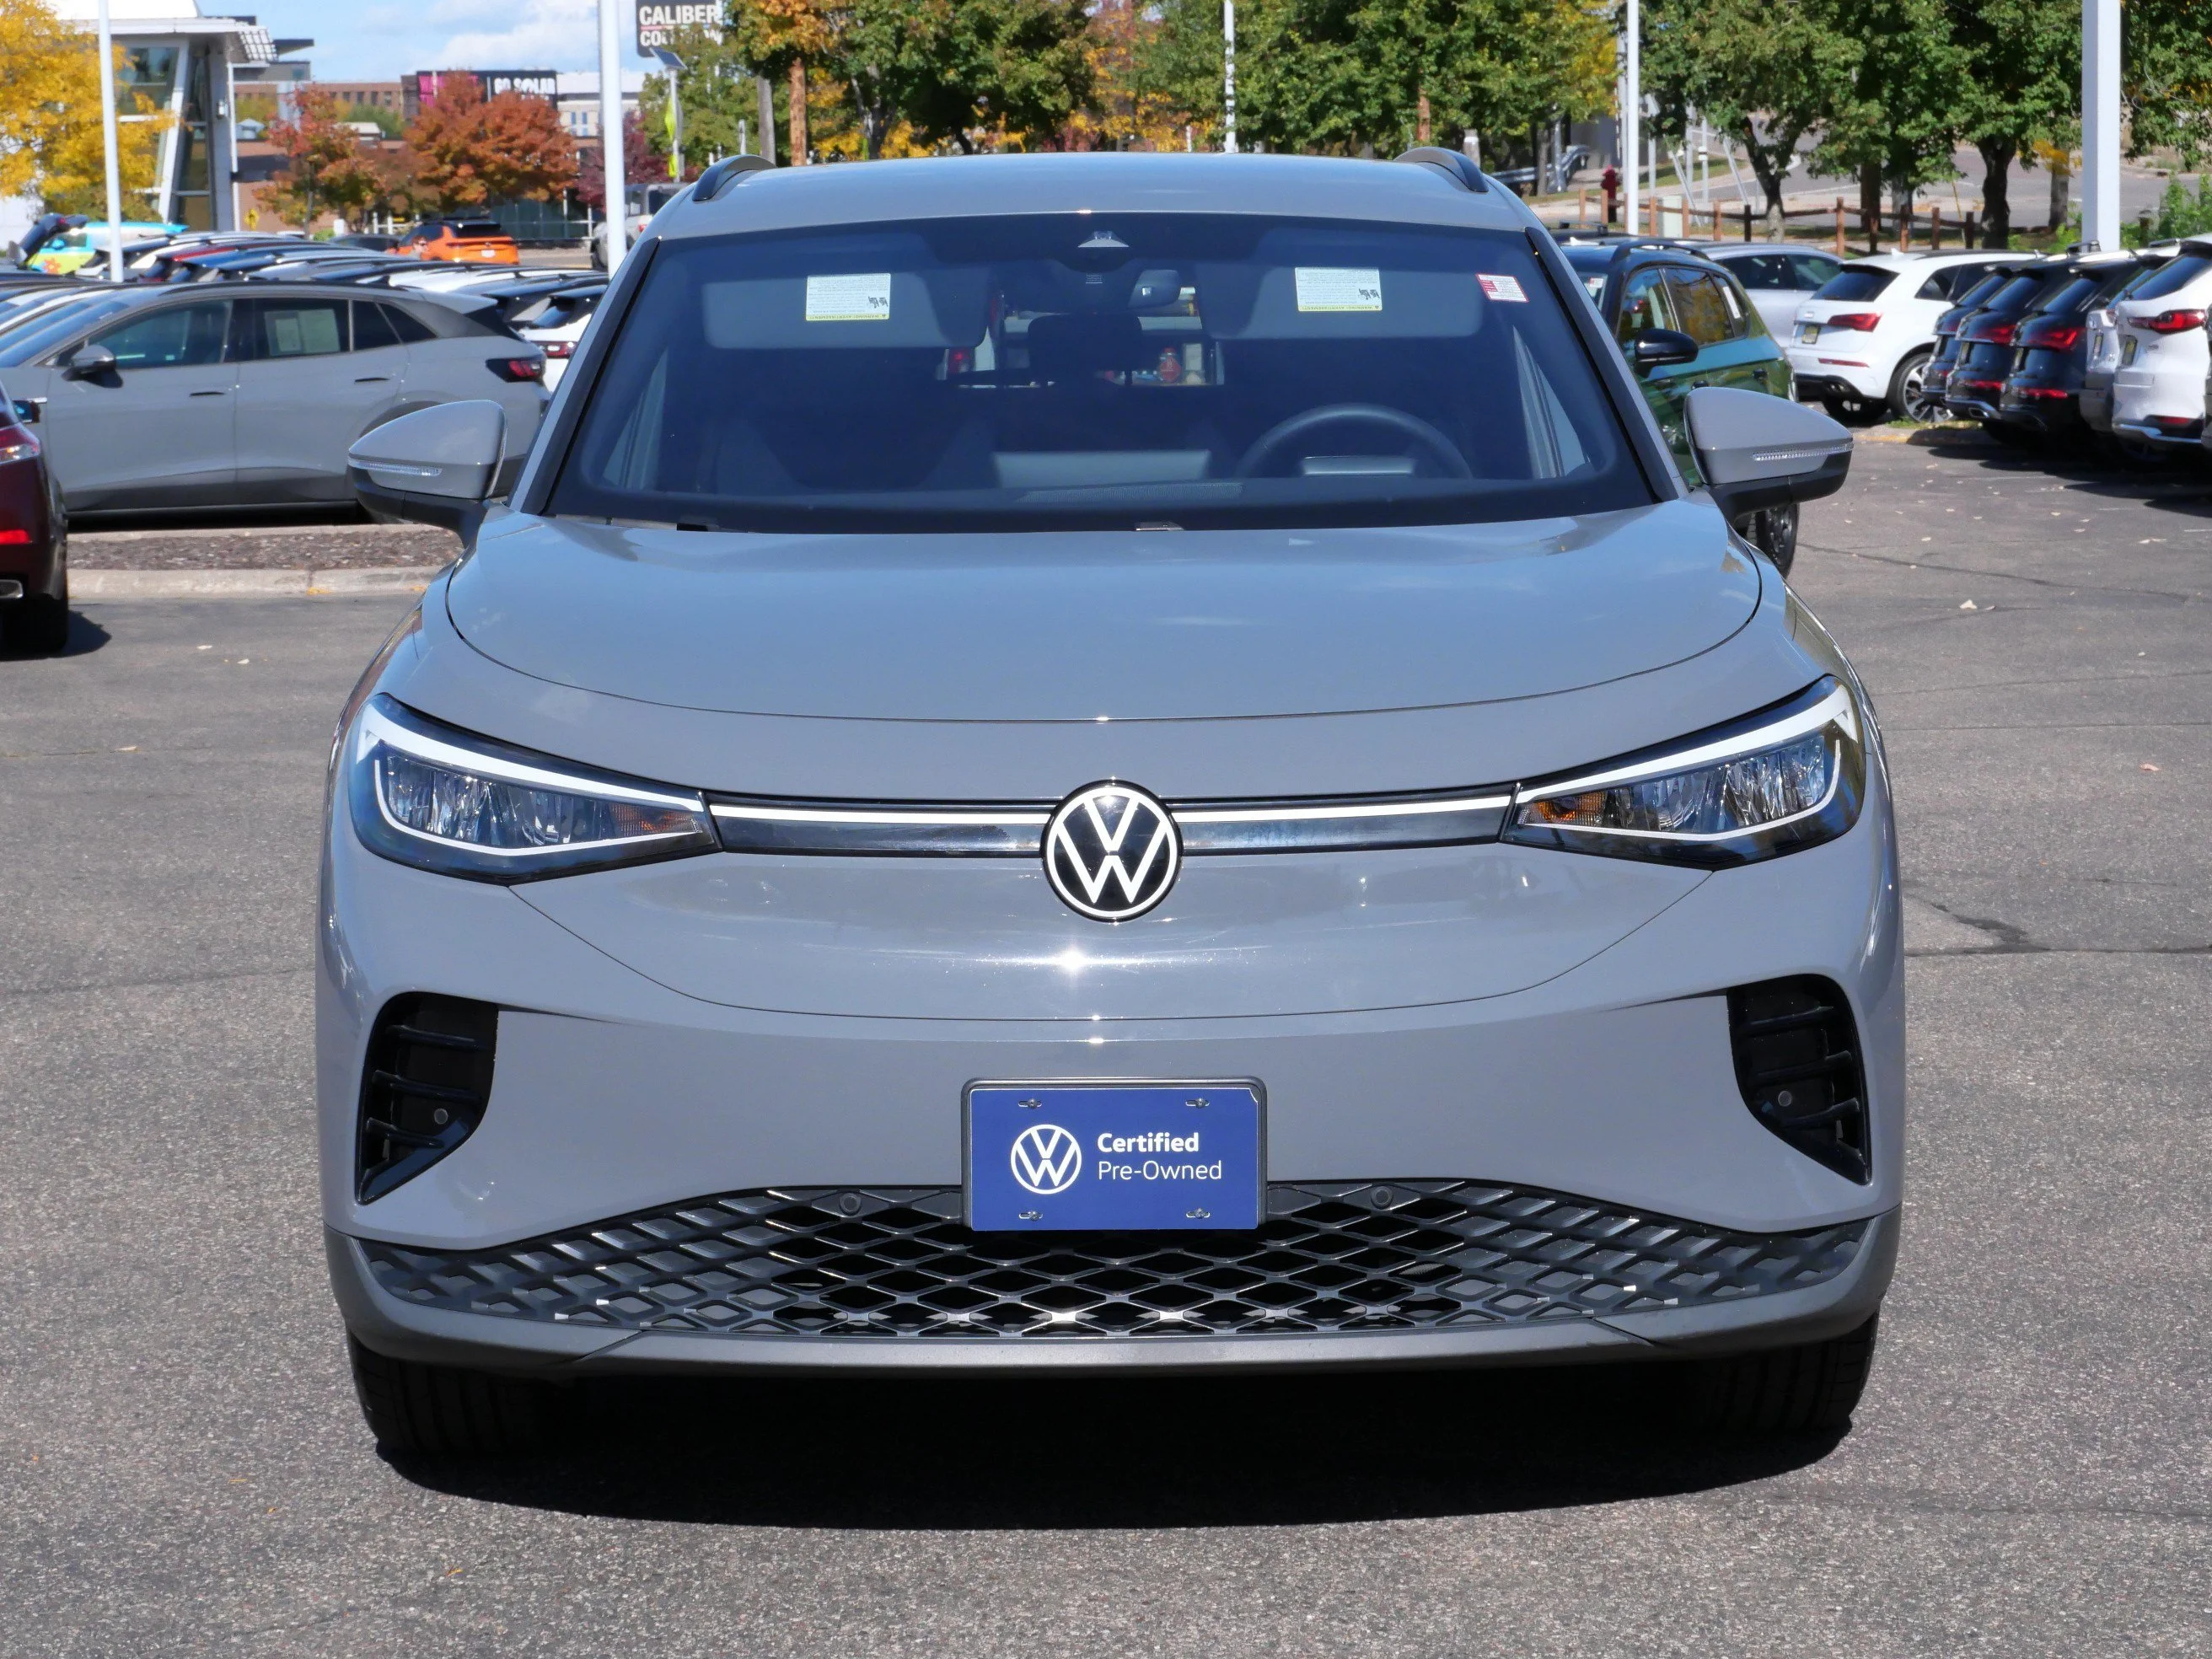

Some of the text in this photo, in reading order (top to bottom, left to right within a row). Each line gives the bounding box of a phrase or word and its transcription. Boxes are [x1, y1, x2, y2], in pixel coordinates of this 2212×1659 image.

[639, 4, 722, 25] CALIBER
[1050, 790, 1174, 909] VW
[1098, 1132, 1200, 1152] Certified
[1013, 1126, 1079, 1189] VW
[1098, 1160, 1222, 1180] Pre-Owned
